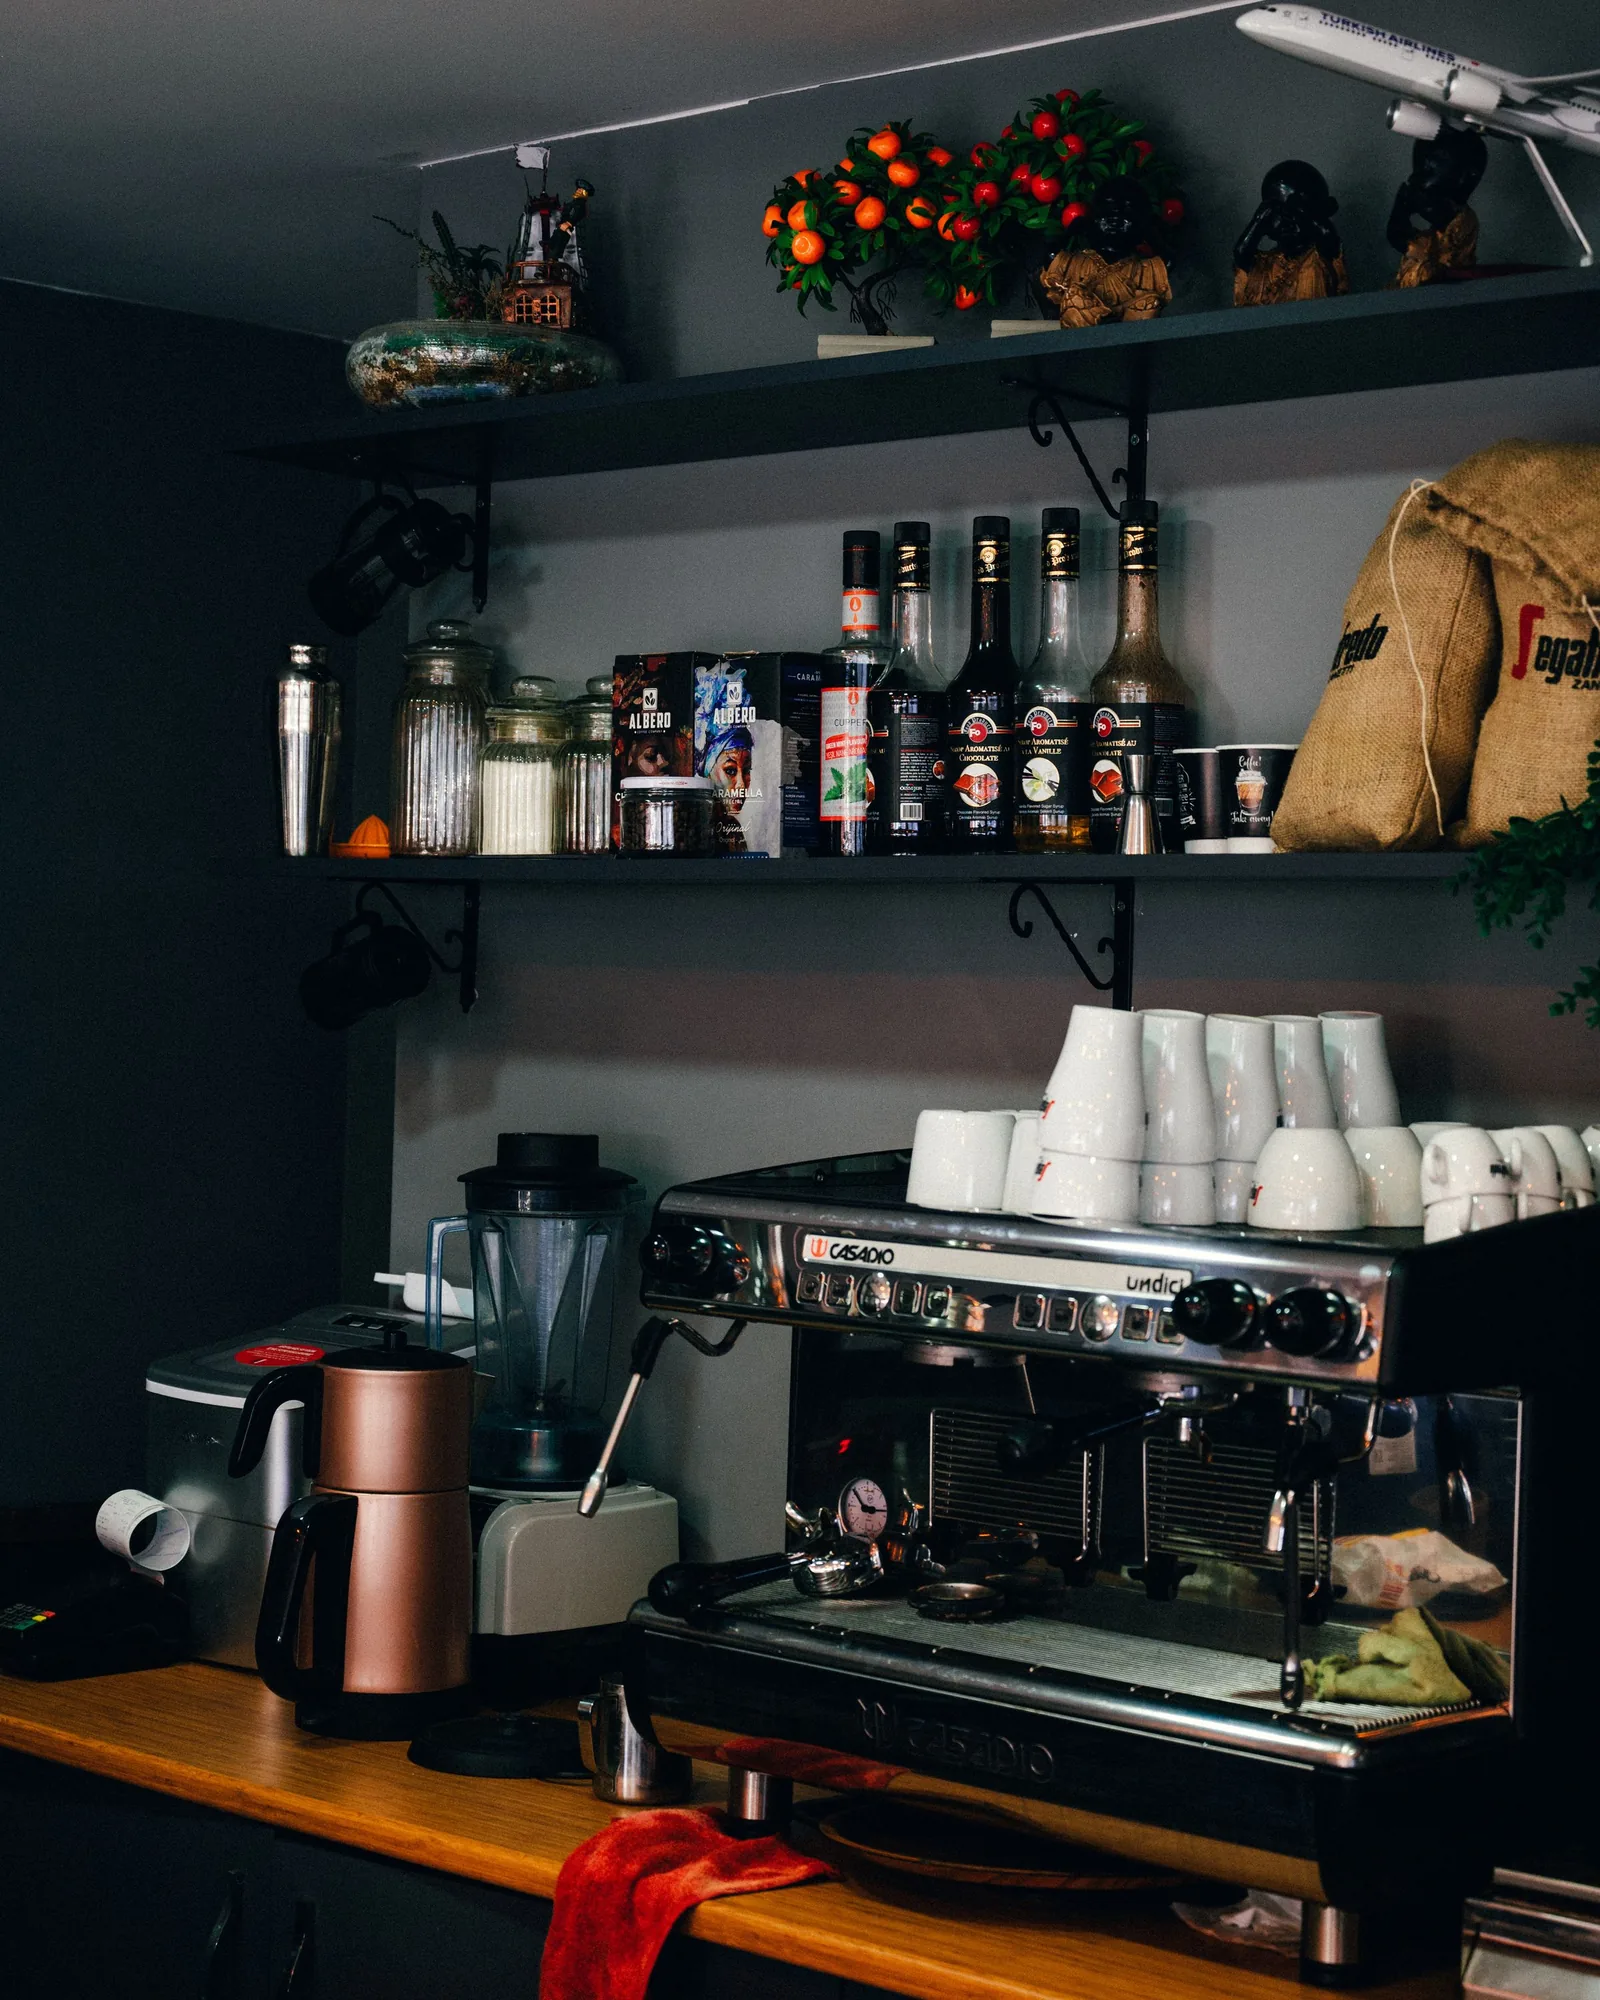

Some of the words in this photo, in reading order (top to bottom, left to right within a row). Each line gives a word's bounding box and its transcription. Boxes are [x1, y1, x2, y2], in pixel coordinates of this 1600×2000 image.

[1321, 12, 1386, 39] TURKISH
[1388, 34, 1456, 61] AIRLINES
[628, 712, 671, 730] ALBERO
[713, 706, 756, 725] ALBERO
[1031, 721, 1042, 732] Fo
[1097, 722, 1107, 733] Fo
[969, 728, 981, 739] Fo
[1031, 737, 1069, 746] AROMATISÉ
[965, 744, 1001, 753] AROMATISÉ
[1032, 746, 1062, 755] VANILLE
[959, 754, 999, 762] CHOCOLATE
[1238, 755, 1262, 771] Coffee!
[711, 788, 763, 798] ARAMELLA
[1230, 810, 1248, 825] Take
[829, 1243, 895, 1265] CASADIO
[1126, 1273, 1184, 1295] undici
